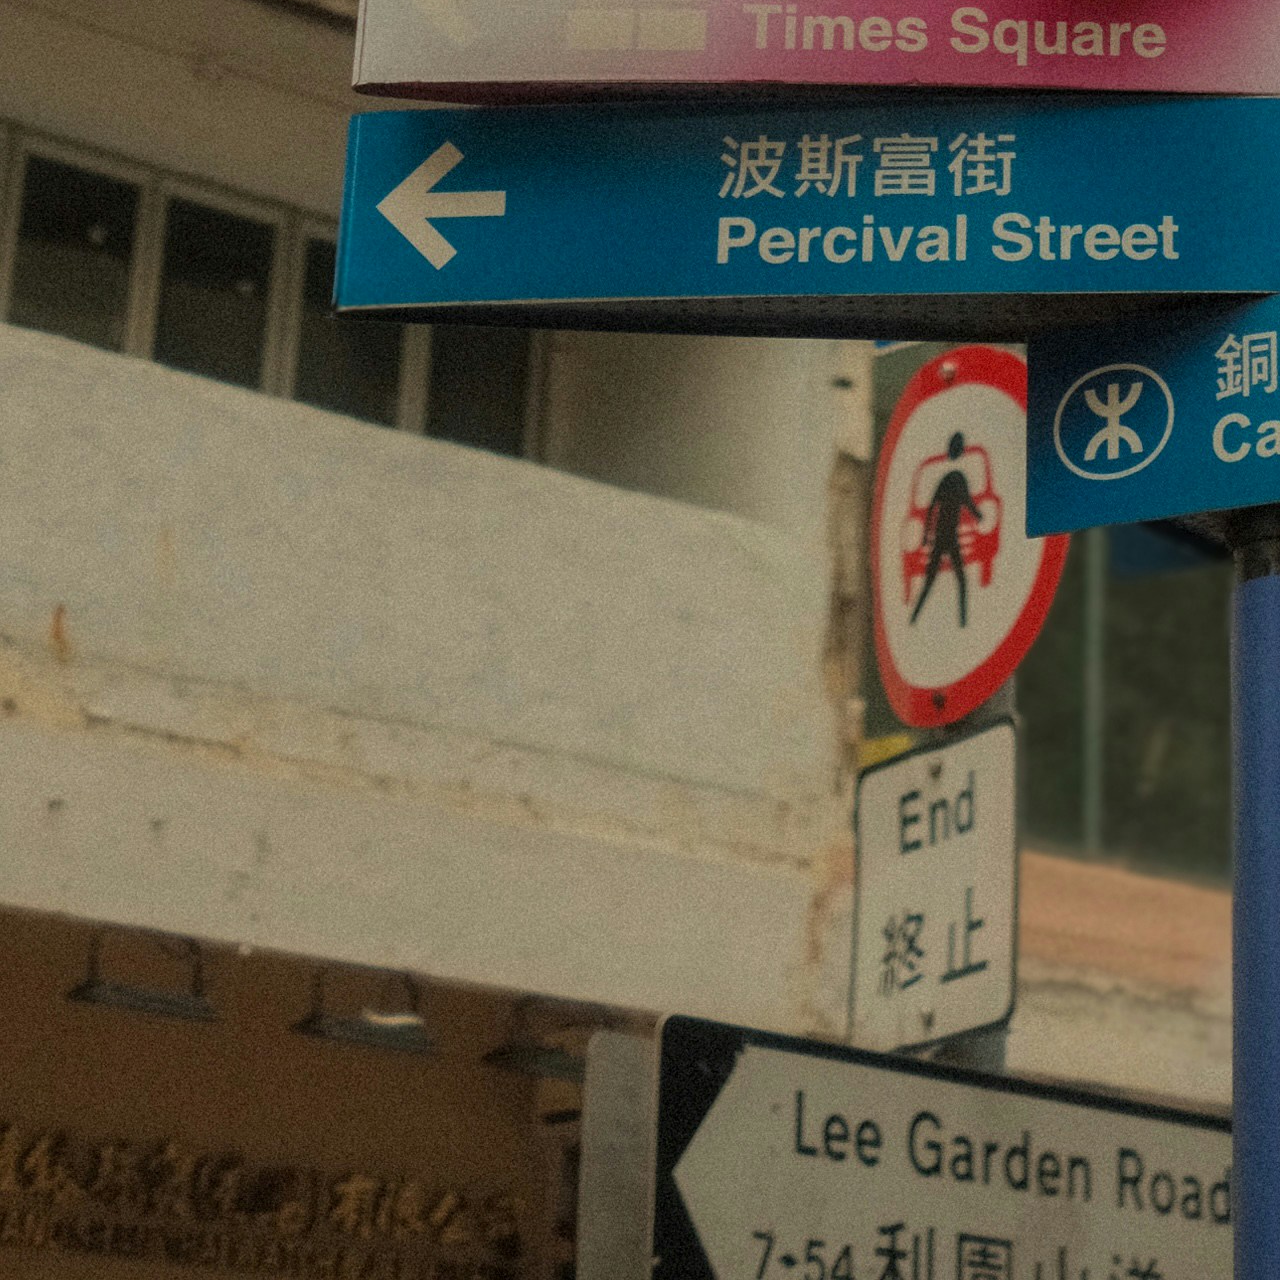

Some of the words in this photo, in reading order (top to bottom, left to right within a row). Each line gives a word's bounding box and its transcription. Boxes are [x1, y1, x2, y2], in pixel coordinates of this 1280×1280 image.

[742, 4, 928, 53] Times
[950, 6, 1167, 66] Square
[717, 133, 1017, 200] 波斯富街
[716, 214, 968, 265] Percival
[991, 212, 1180, 261] Street
[900, 769, 976, 855] End
[795, 1090, 883, 1167] Lee
[908, 1111, 1093, 1201] Garden
